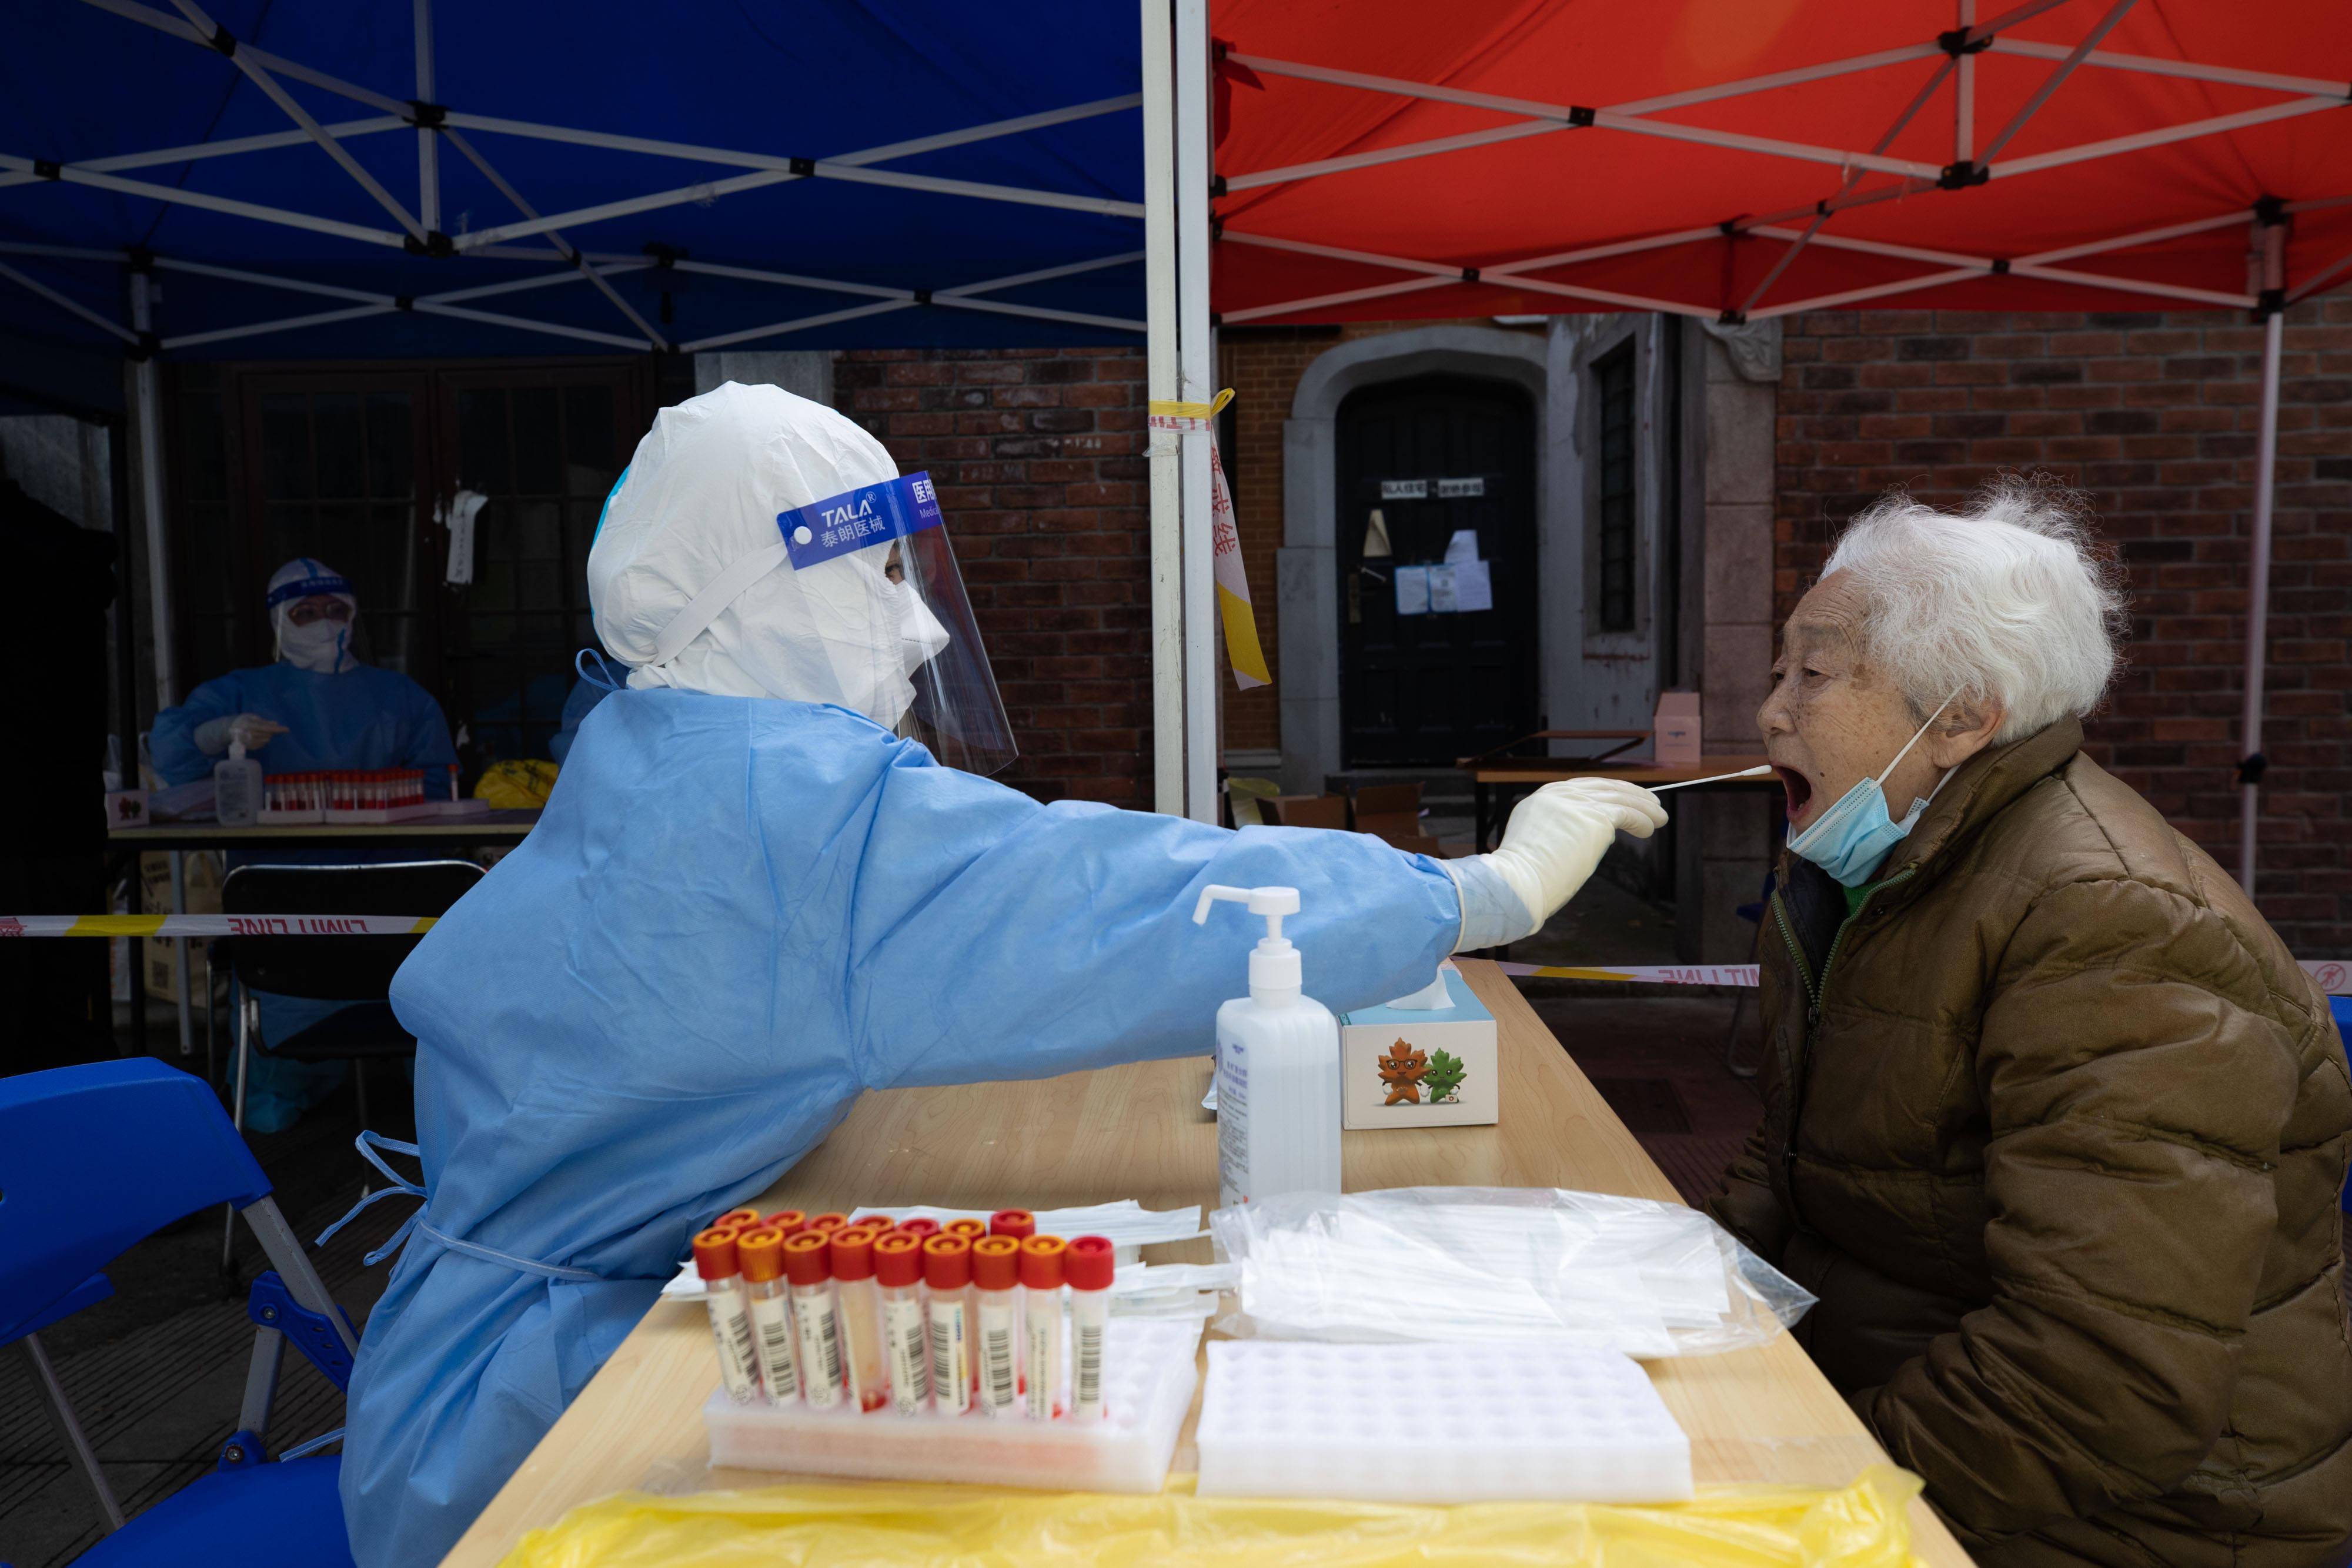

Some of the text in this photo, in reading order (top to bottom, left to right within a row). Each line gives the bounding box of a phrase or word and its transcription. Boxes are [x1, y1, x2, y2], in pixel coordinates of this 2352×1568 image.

[821, 515, 885, 547] 泰朗医械
[228, 918, 289, 934] LINE
